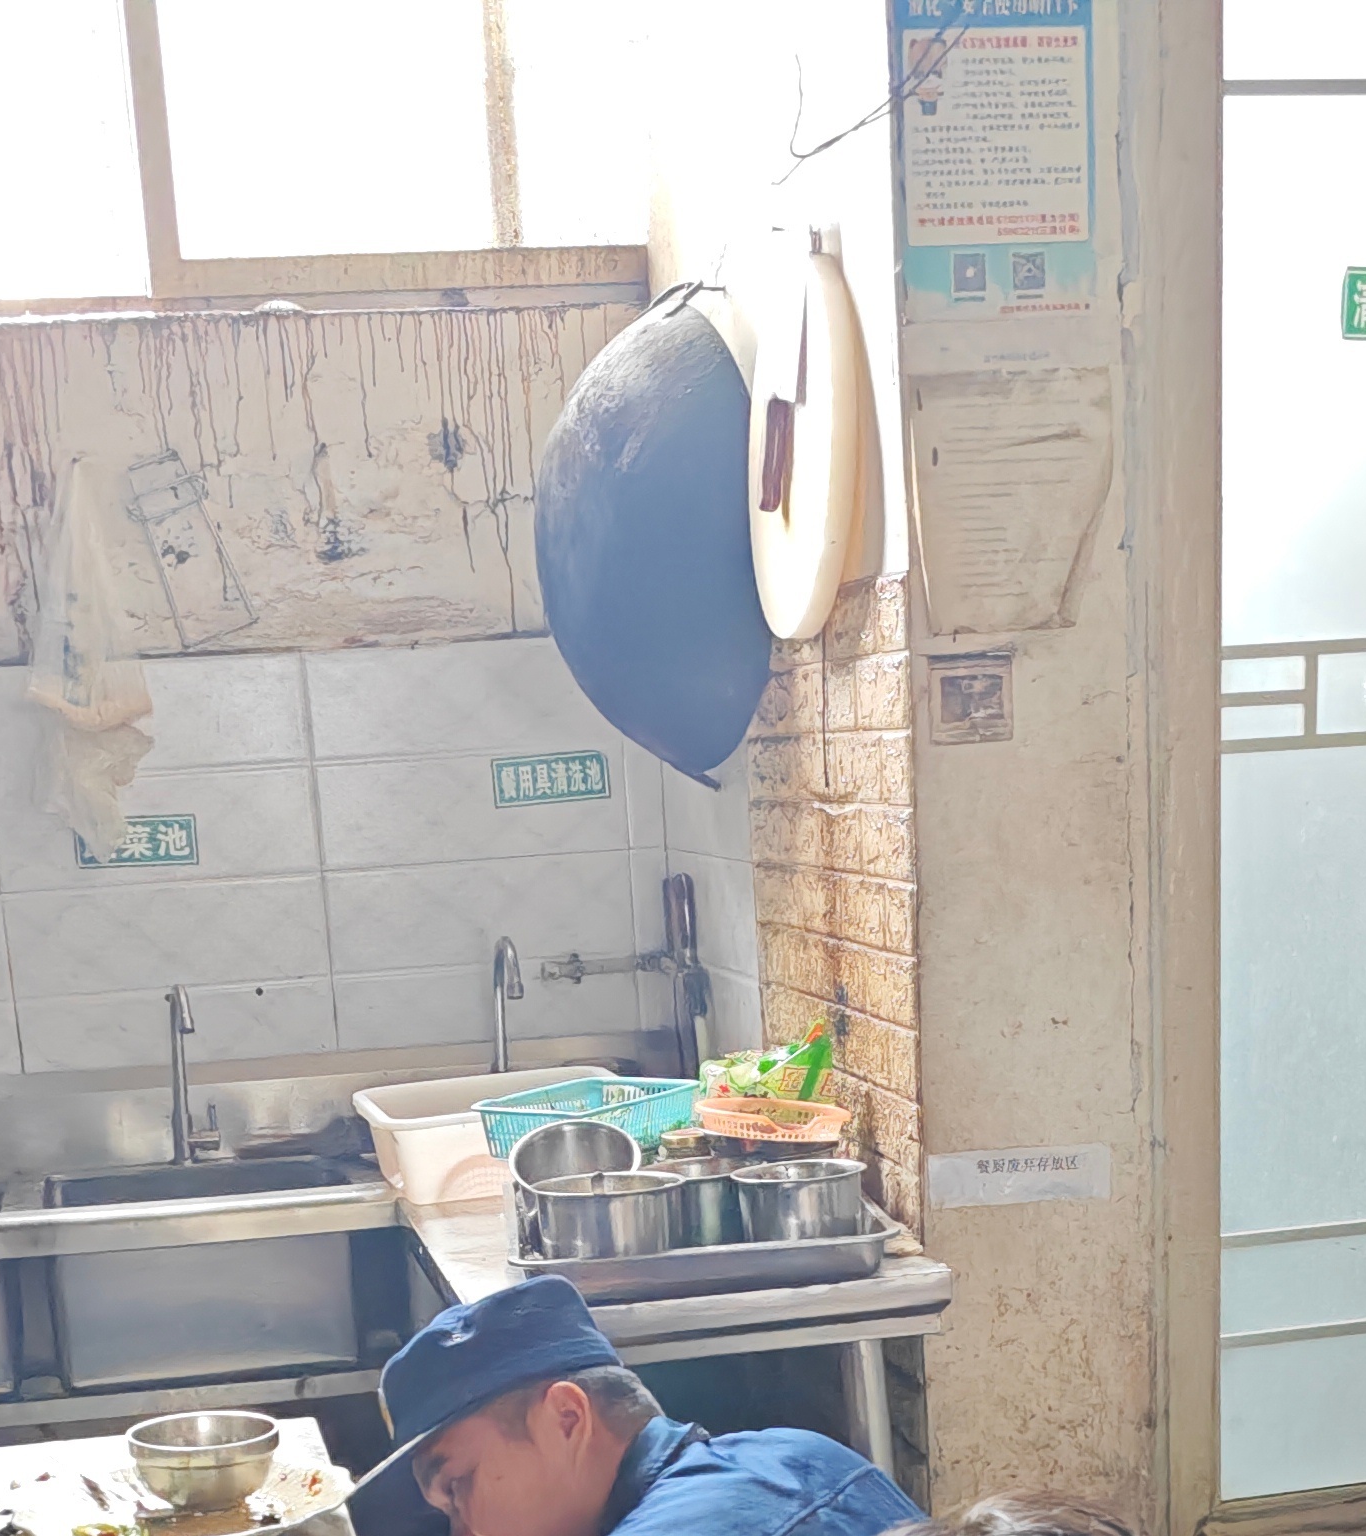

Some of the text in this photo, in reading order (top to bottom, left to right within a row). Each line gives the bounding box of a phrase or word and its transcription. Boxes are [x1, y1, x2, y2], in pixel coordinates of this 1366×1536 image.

[500, 757, 603, 800] 餐用具清洗池
